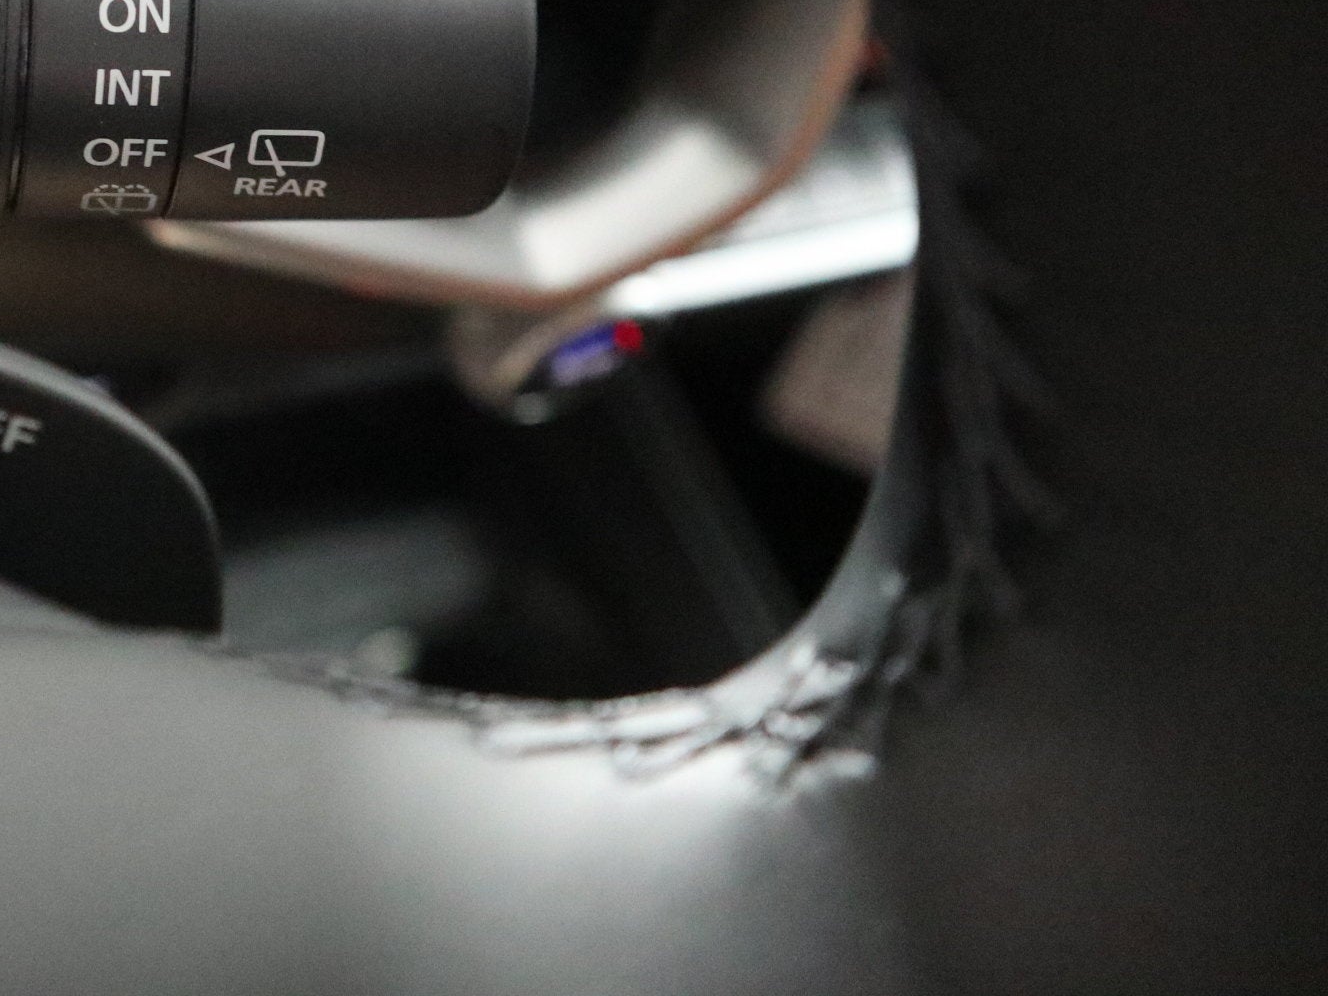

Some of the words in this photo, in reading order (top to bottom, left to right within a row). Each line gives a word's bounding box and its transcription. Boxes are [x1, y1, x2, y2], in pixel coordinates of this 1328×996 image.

[94, 68, 172, 107] INT
[83, 138, 169, 168] OFF
[233, 177, 328, 198] REAR
